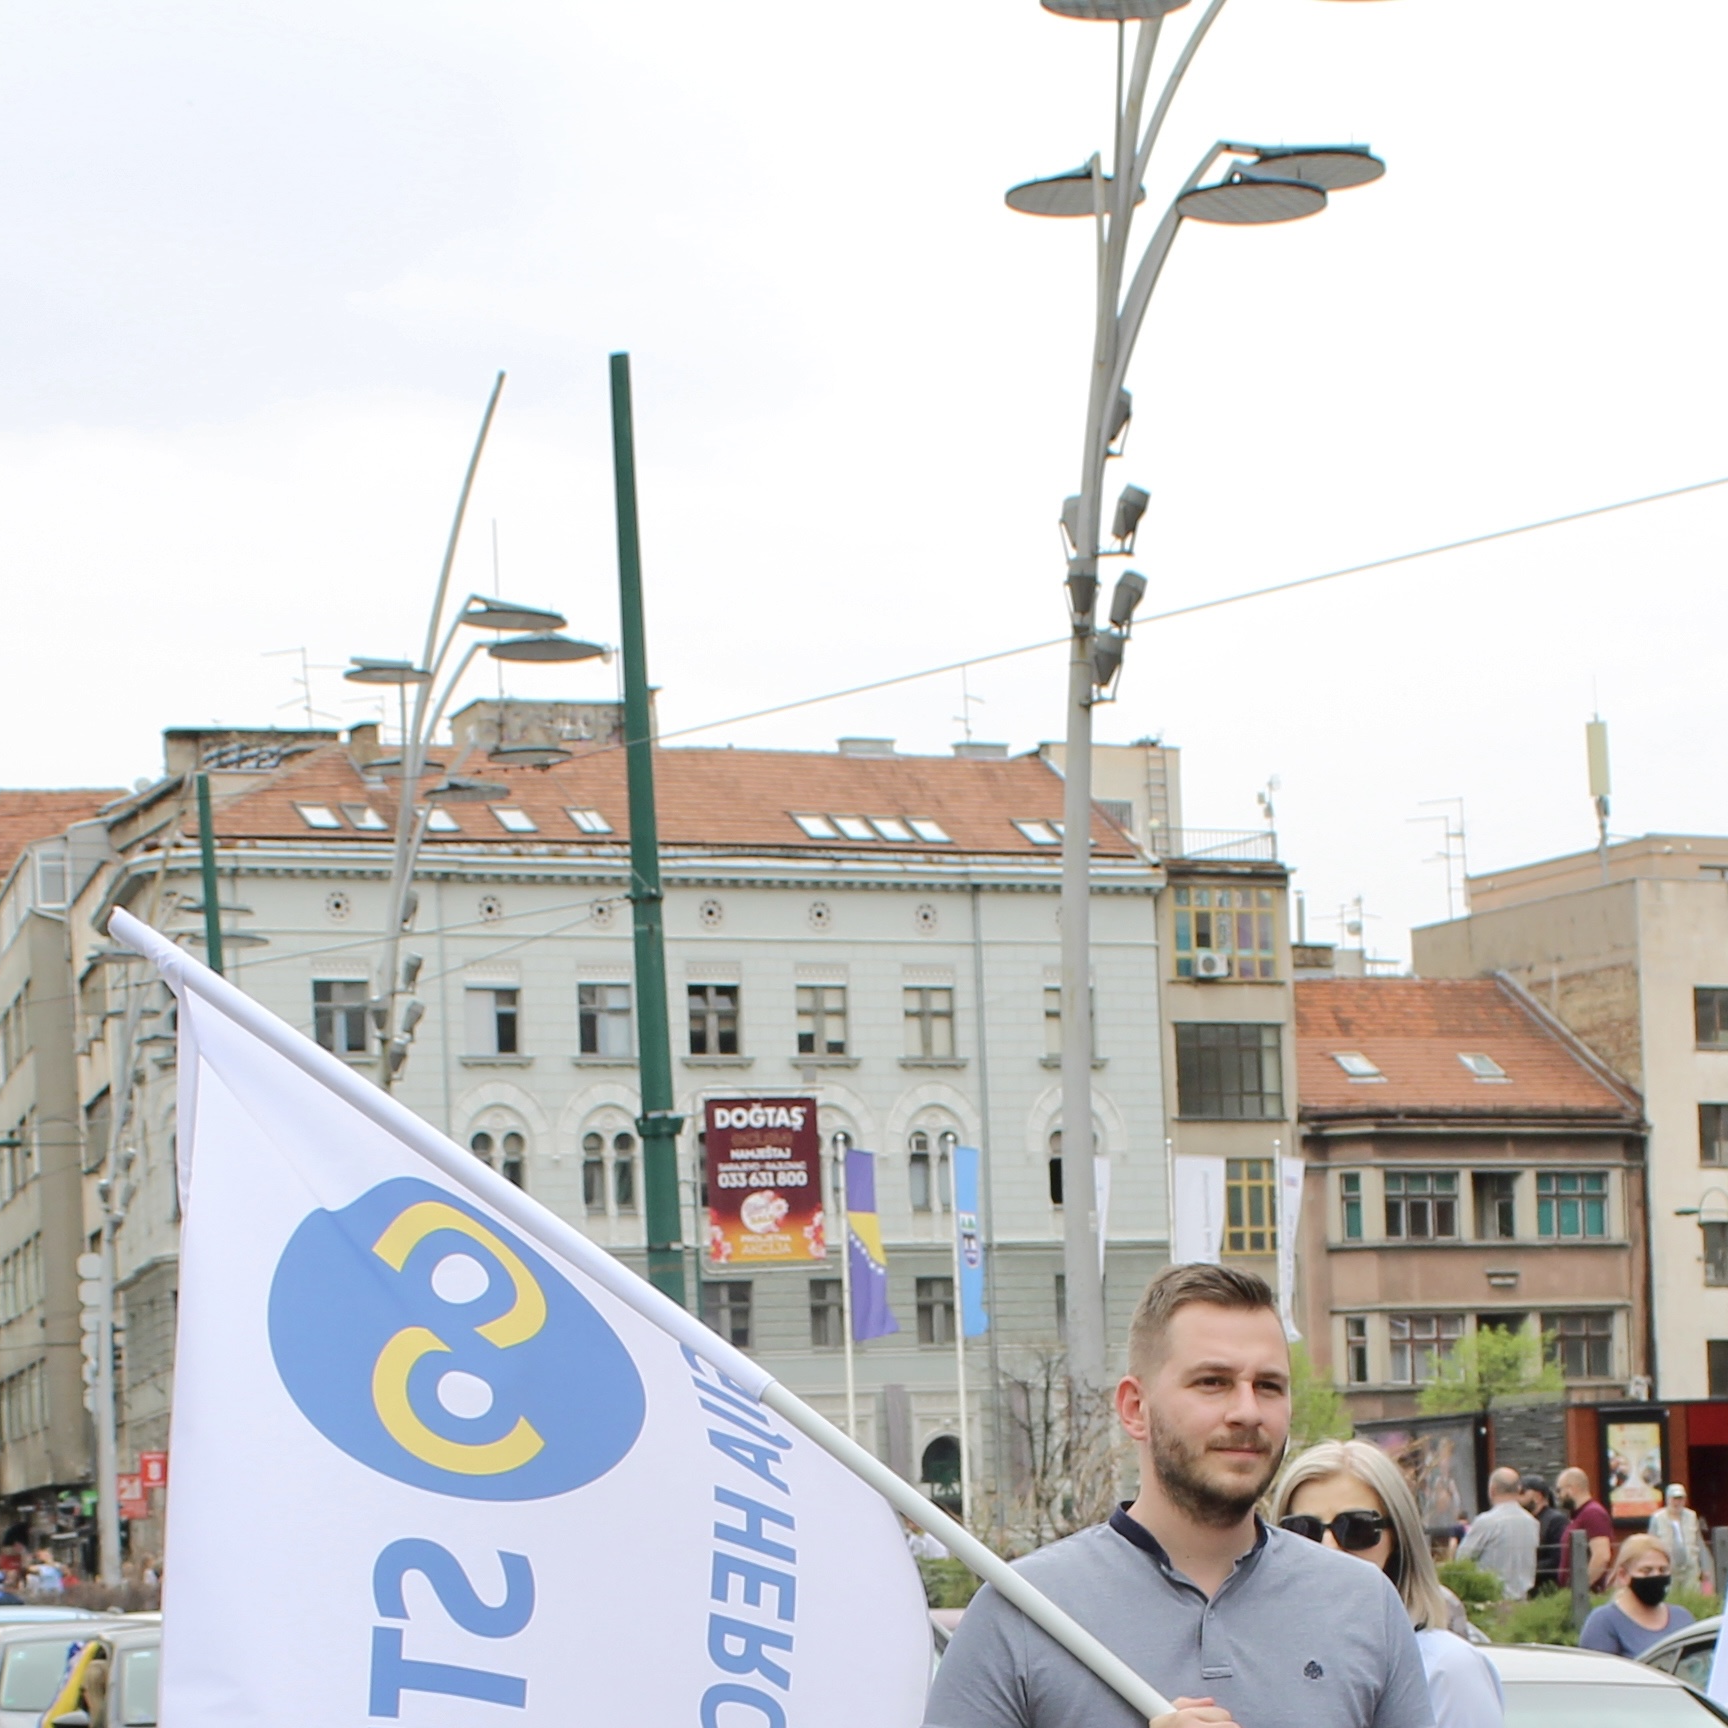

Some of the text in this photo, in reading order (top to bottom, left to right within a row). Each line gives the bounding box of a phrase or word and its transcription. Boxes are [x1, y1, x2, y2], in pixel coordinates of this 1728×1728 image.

[714, 1103, 805, 1132] DOĞTAŞ
[717, 1171, 808, 1189] 033 631 800
